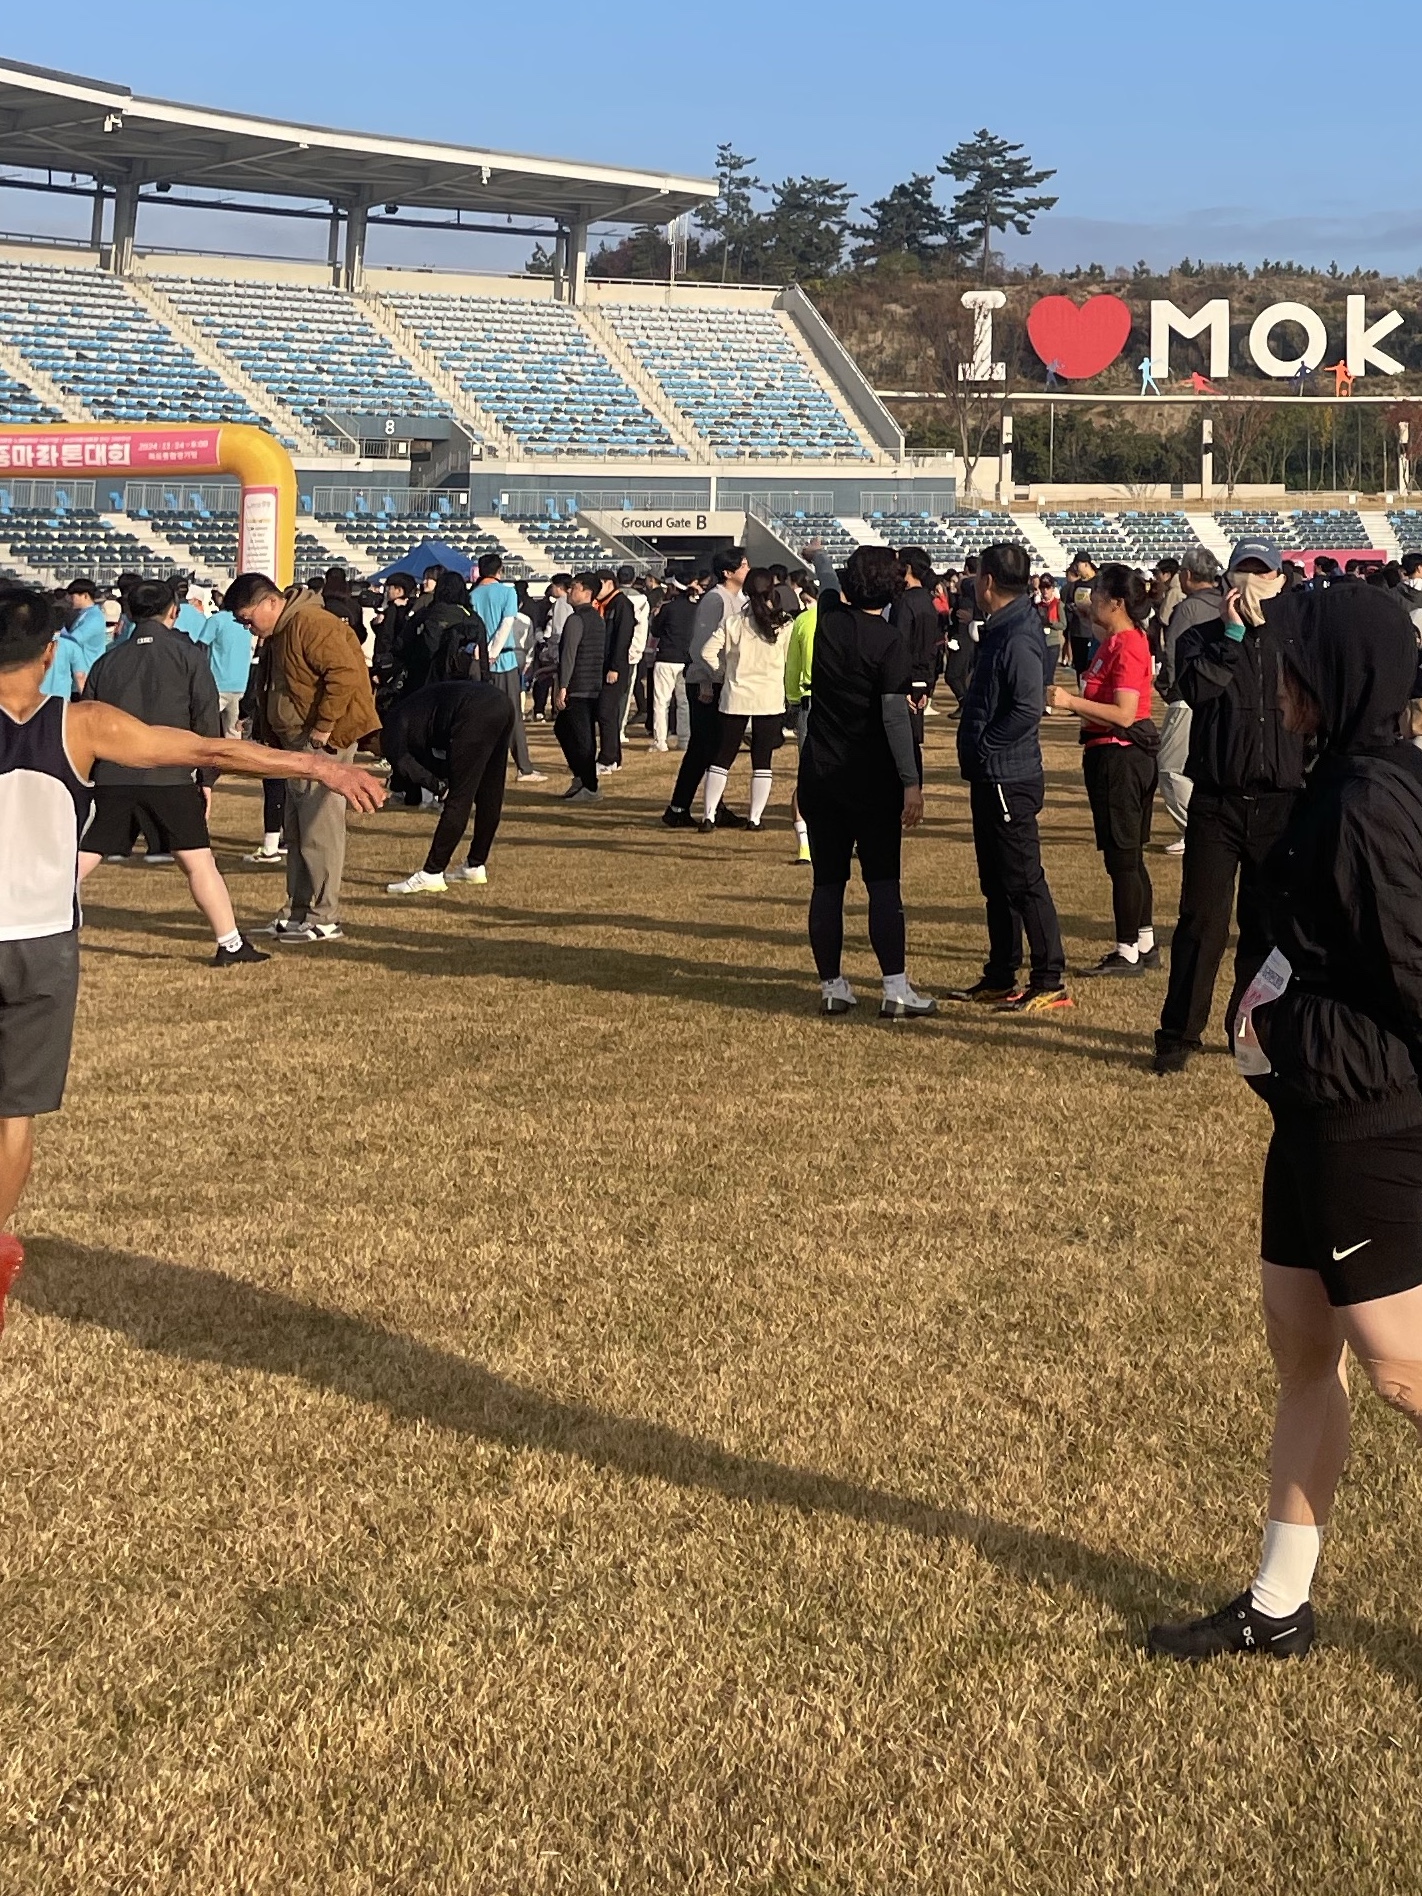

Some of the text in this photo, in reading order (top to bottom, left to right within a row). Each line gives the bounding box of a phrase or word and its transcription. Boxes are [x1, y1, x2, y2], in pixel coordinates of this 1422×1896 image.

[958, 290, 1007, 381] I
[385, 419, 395, 435] 8
[621, 515, 707, 530] Ground Gate B
